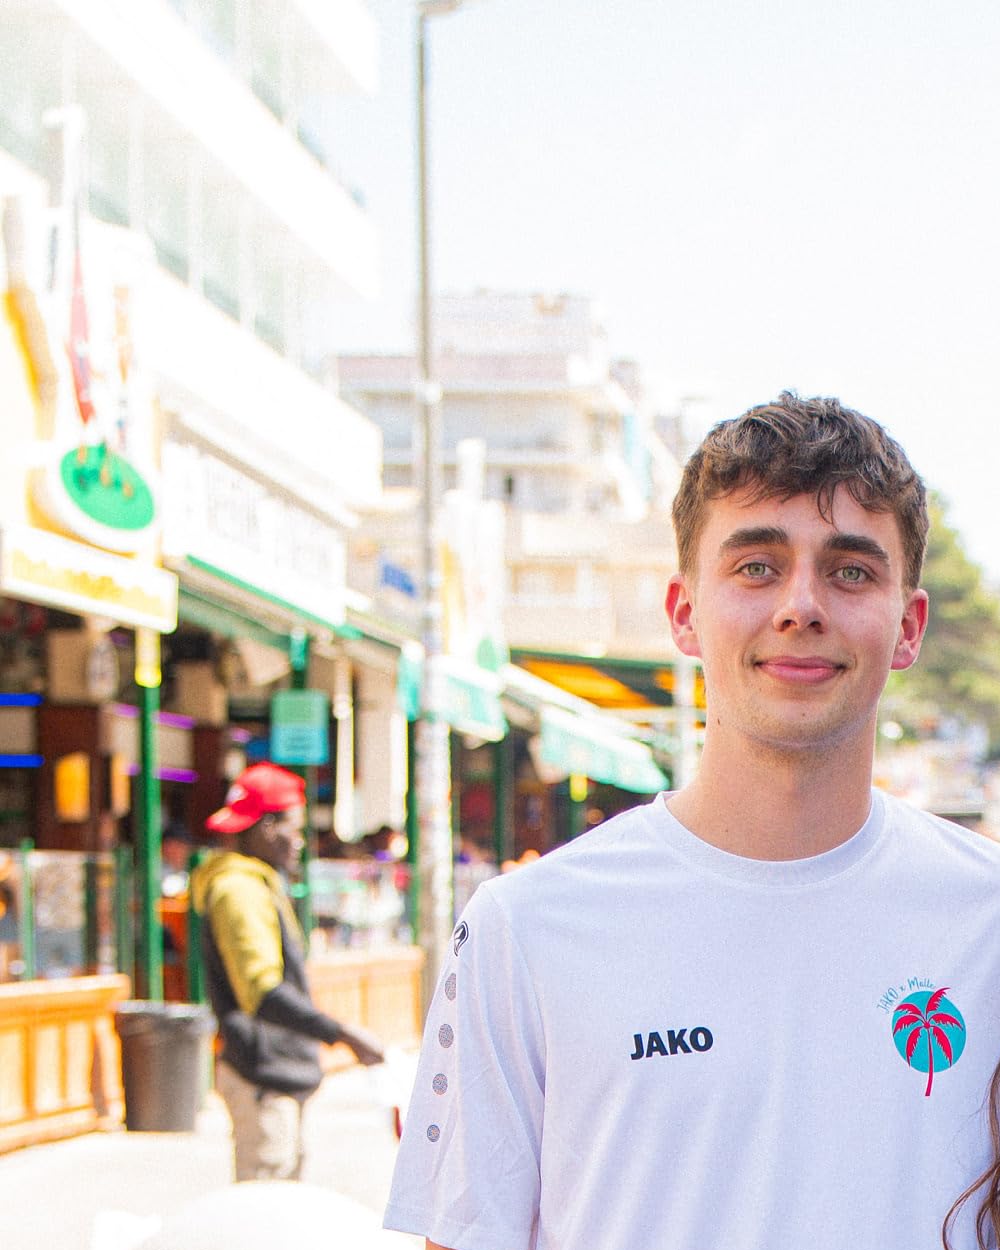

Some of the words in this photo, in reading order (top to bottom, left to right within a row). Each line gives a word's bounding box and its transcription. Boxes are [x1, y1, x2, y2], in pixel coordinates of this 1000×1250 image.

[876, 987, 899, 1014] JAKO
[907, 976, 937, 990] Malle
[630, 1026, 714, 1060] JAKO
